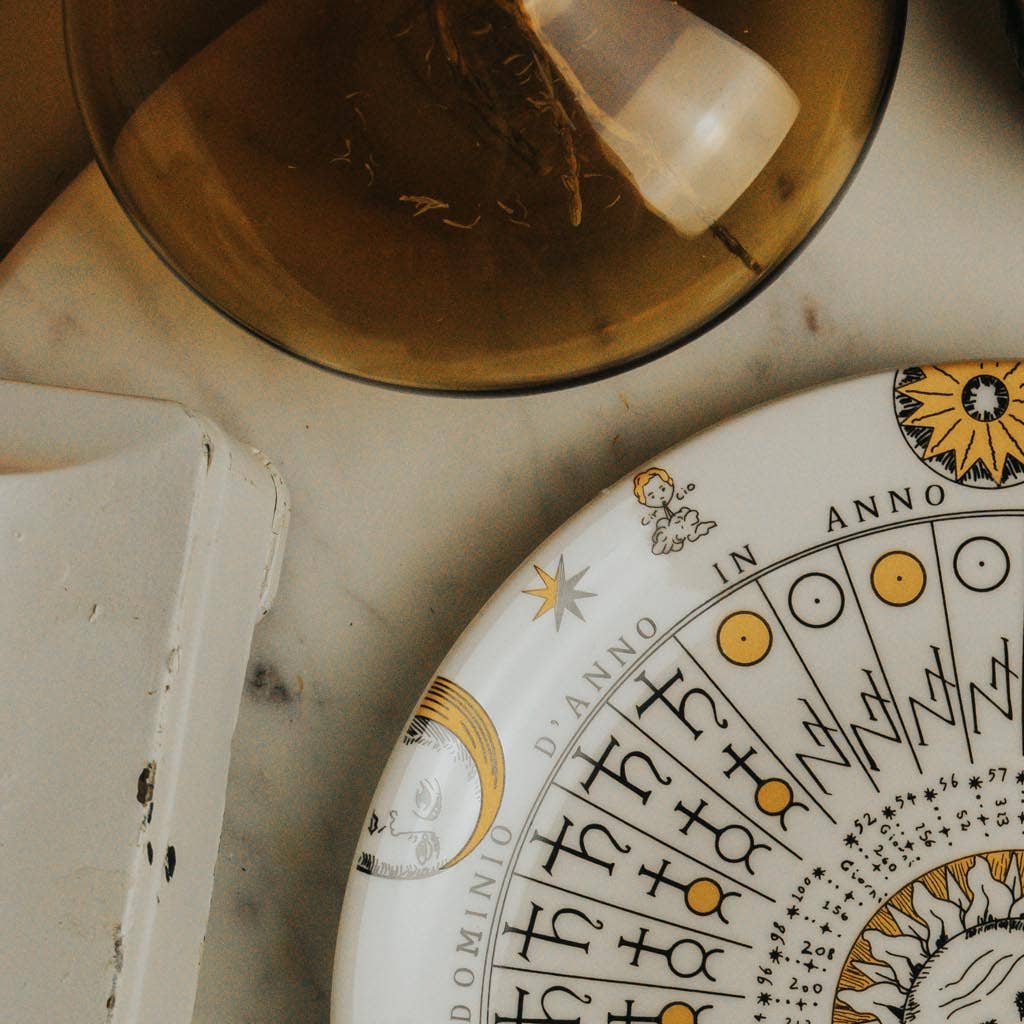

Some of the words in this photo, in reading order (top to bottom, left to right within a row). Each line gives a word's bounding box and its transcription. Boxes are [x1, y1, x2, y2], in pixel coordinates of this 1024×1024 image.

[449, 826, 512, 1023] DOMINIO
[534, 617, 657, 758] D'ANNO
[712, 544, 757, 584] IN
[827, 484, 945, 533] ANNO
[939, 773, 958, 791] 56
[988, 767, 1007, 782] 57
[895, 792, 916, 809] 54
[854, 813, 877, 835] 52
[792, 877, 811, 902] 100
[770, 921, 786, 946] 98
[757, 965, 773, 986] 96
